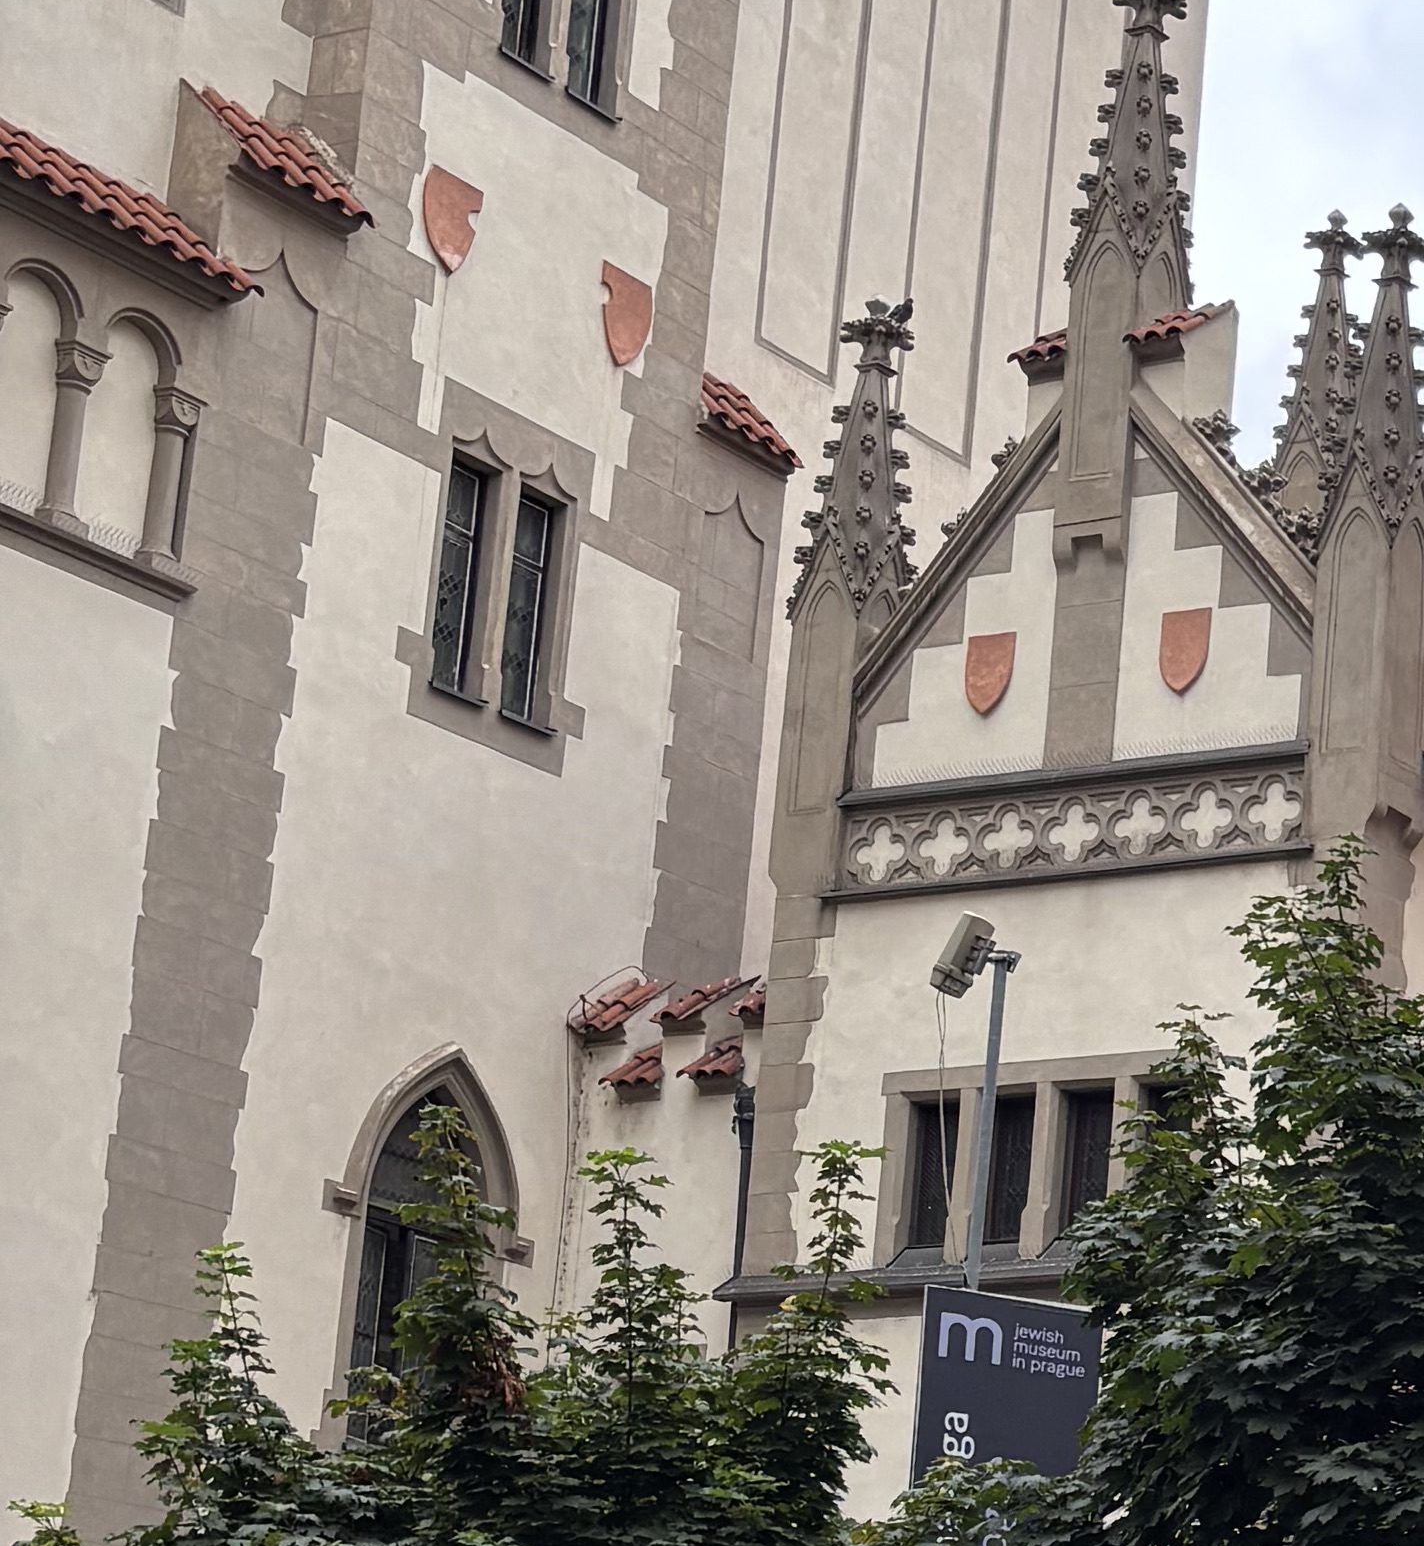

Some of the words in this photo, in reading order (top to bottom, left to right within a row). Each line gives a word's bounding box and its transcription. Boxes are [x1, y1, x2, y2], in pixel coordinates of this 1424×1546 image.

[938, 1311, 1003, 1365] m
[1013, 1322, 1064, 1344] jewish
[1013, 1341, 1081, 1362] museum
[1012, 1353, 1026, 1369] in
[1030, 1359, 1086, 1378] prague
